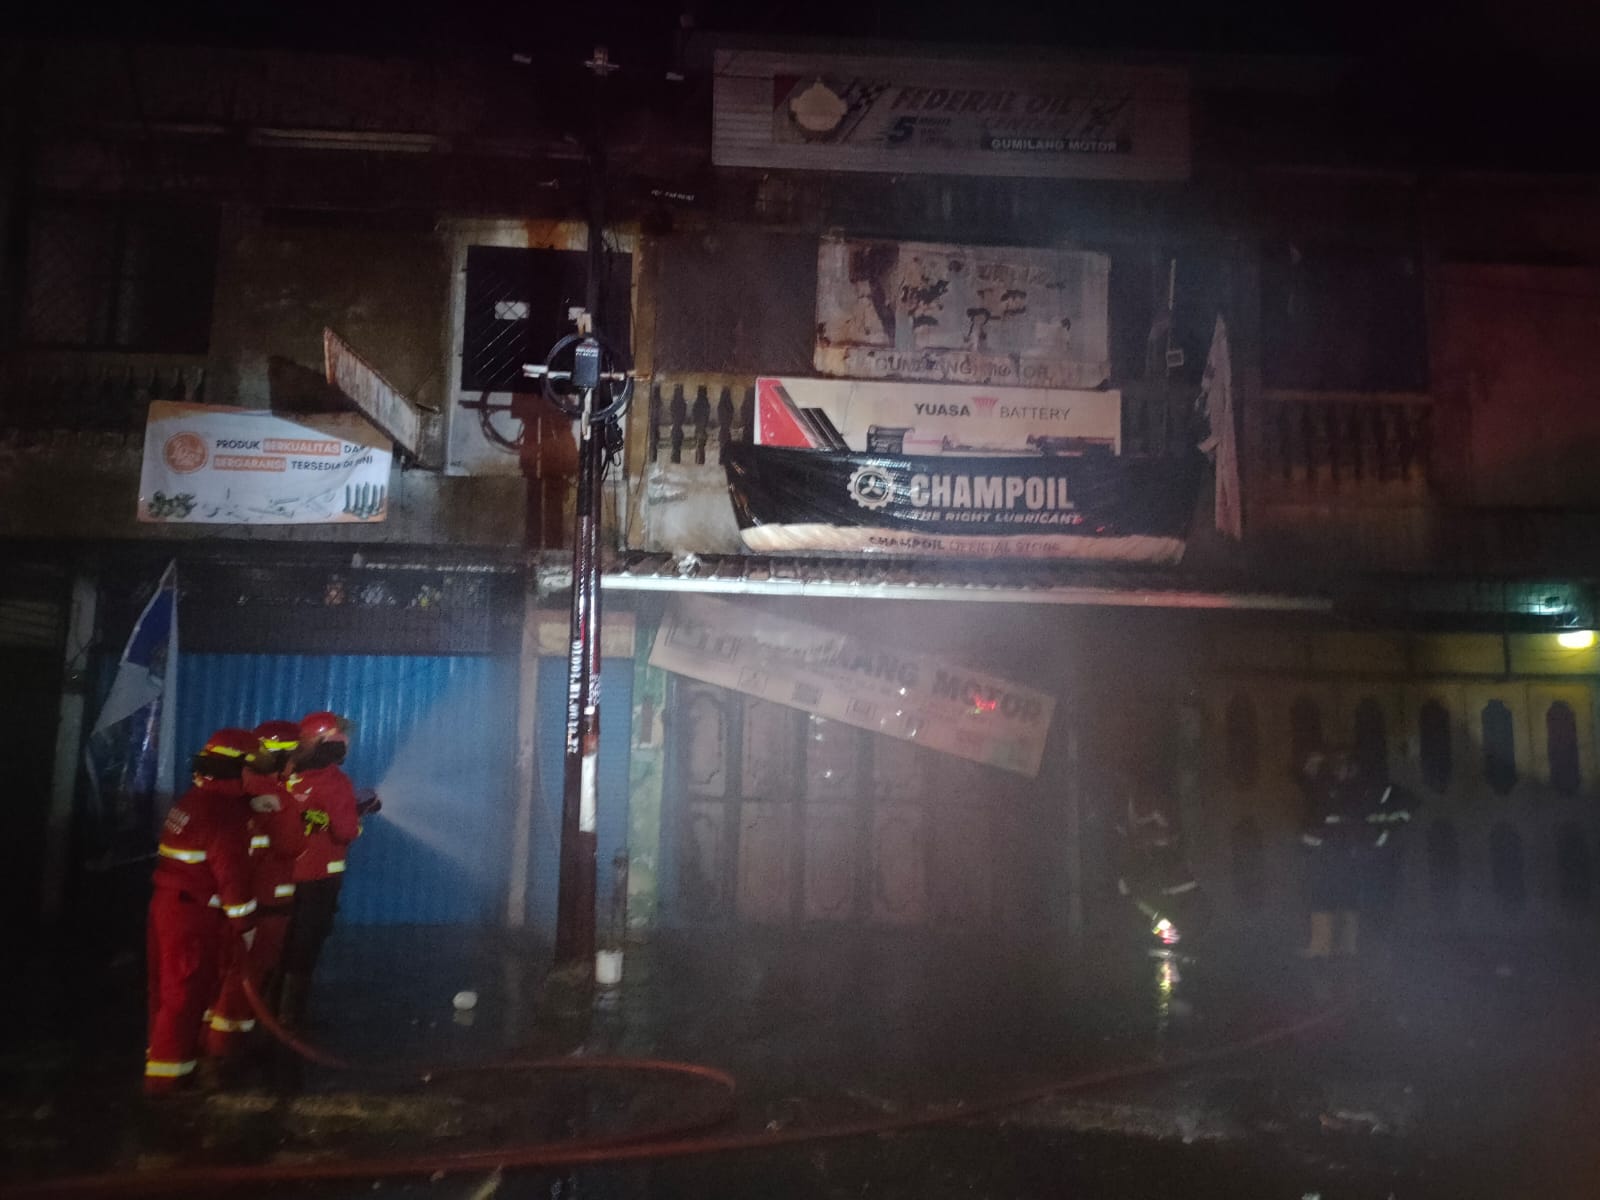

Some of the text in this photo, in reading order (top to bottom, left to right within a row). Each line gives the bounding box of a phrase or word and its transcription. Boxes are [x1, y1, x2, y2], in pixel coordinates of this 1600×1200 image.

[991, 137, 1118, 153] GUMILANG MOTOR
[876, 355, 973, 376] GUMIANG
[914, 402, 1071, 422] YUASA BATTERY
[216, 439, 261, 450] PRODUK
[291, 460, 341, 470] TERSEDIA
[910, 473, 1074, 510] CHAMPOIL
[945, 511, 990, 522] RIGHT
